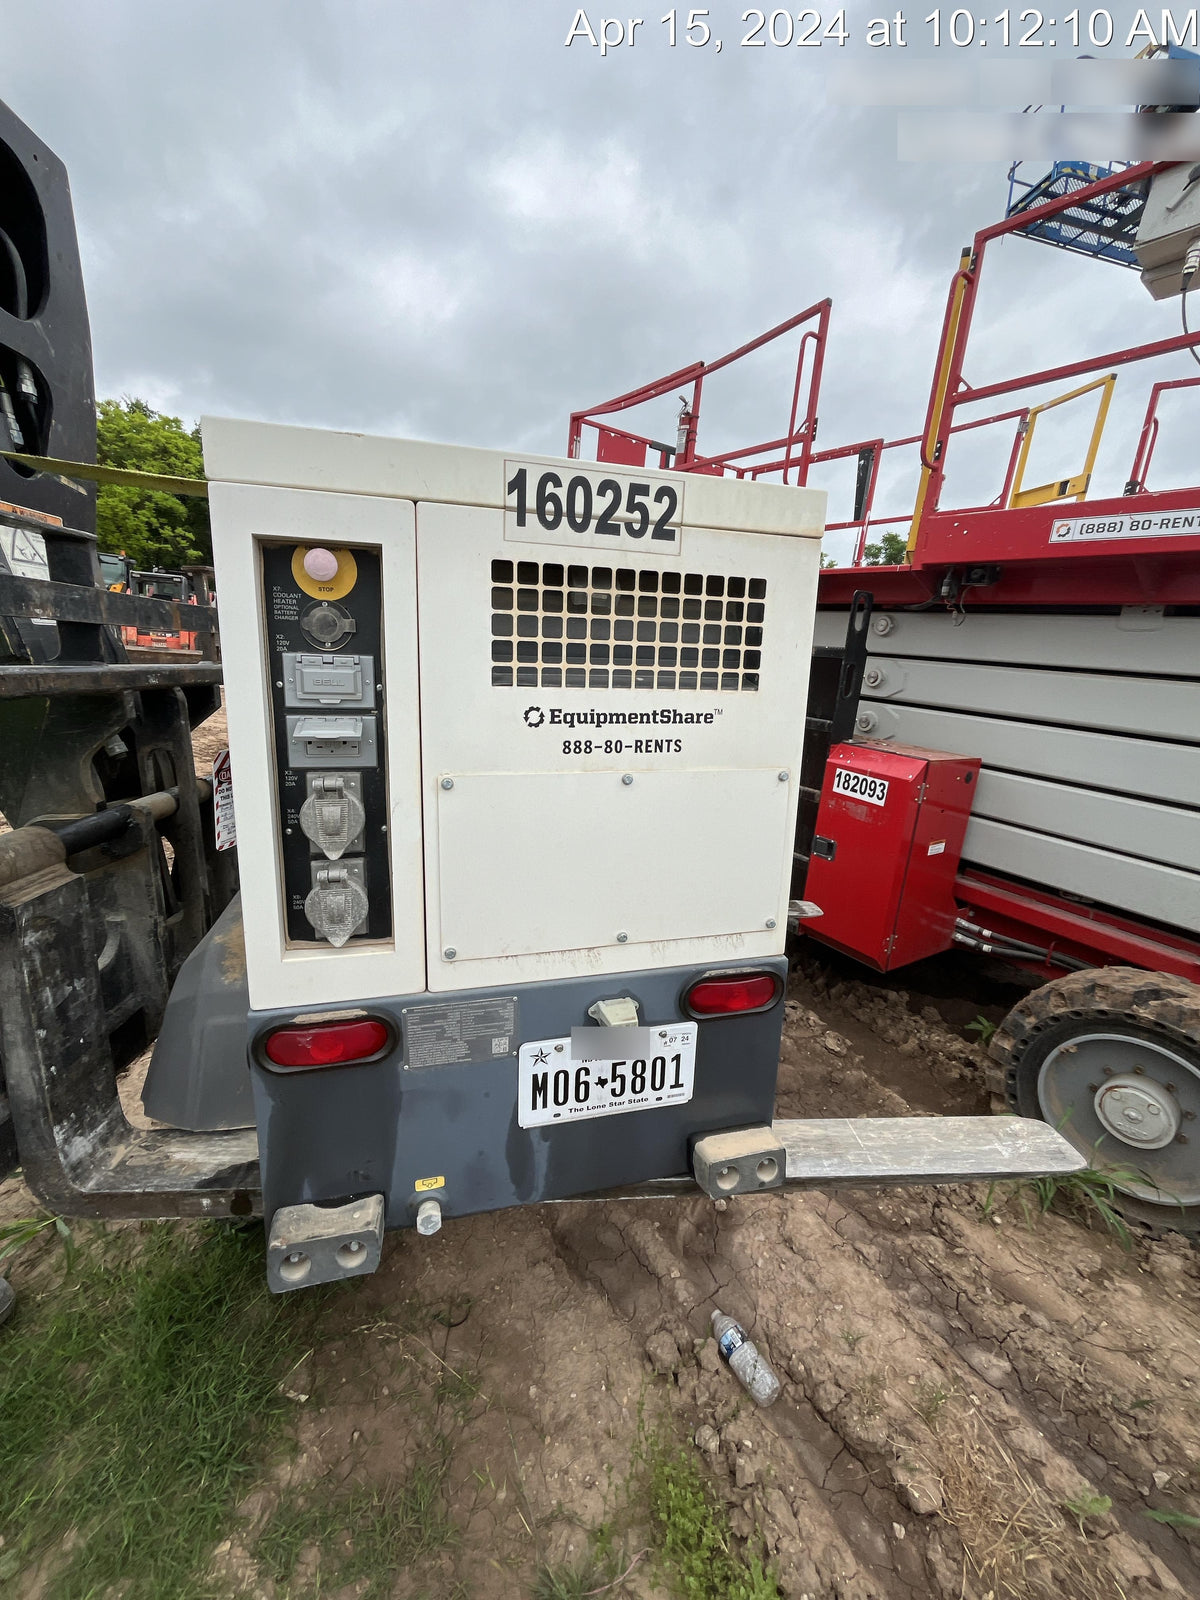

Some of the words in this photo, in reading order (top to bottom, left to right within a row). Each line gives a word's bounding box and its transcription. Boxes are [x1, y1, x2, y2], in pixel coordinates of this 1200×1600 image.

[507, 468, 678, 542] 160252
[1079, 520, 1124, 535] (888)
[562, 739, 682, 754] 888-80-RENTS
[836, 771, 887, 801] 182093
[610, 1053, 684, 1098] 5801
[609, 1100, 626, 1108] Star
[627, 1097, 649, 1105] State
